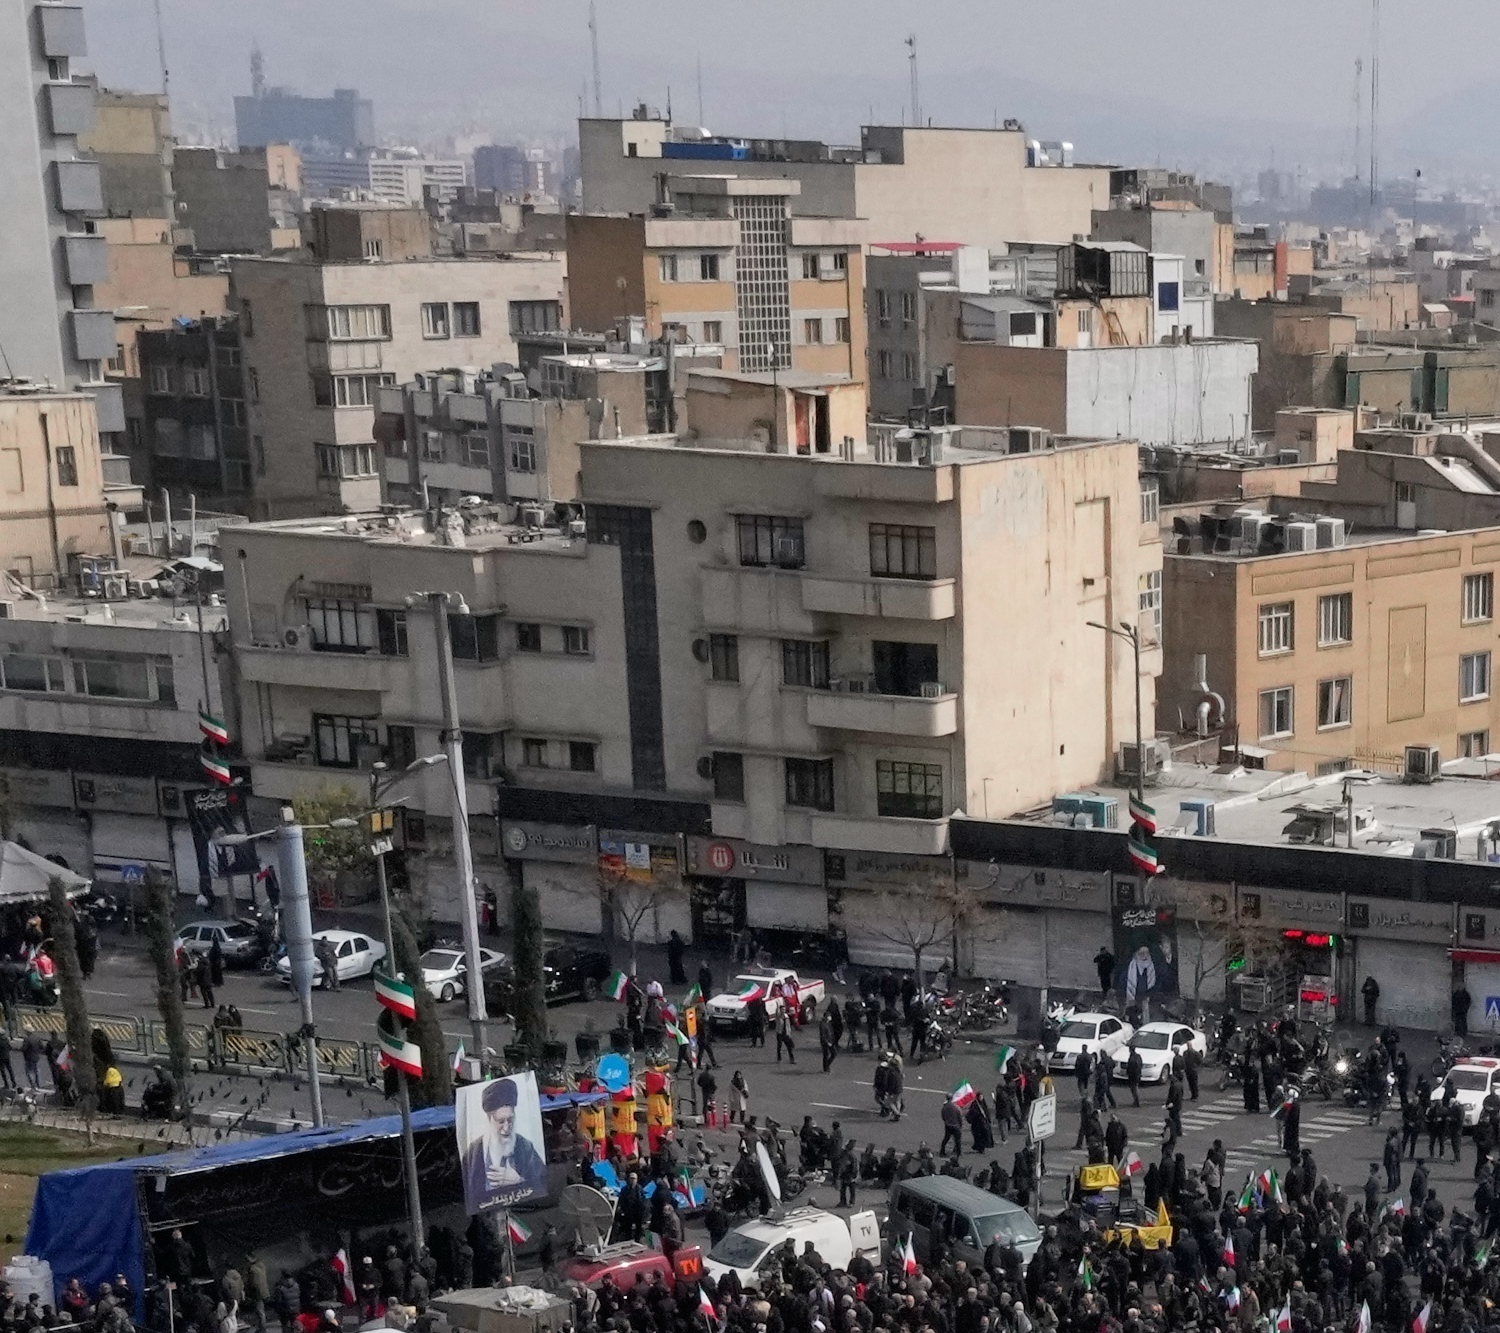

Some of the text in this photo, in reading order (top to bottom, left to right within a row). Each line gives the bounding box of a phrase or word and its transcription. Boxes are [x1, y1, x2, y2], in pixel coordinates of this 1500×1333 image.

[515, 1188, 534, 1202] خدای
[860, 1226, 871, 1237] TV
[680, 1258, 699, 1275] TV
